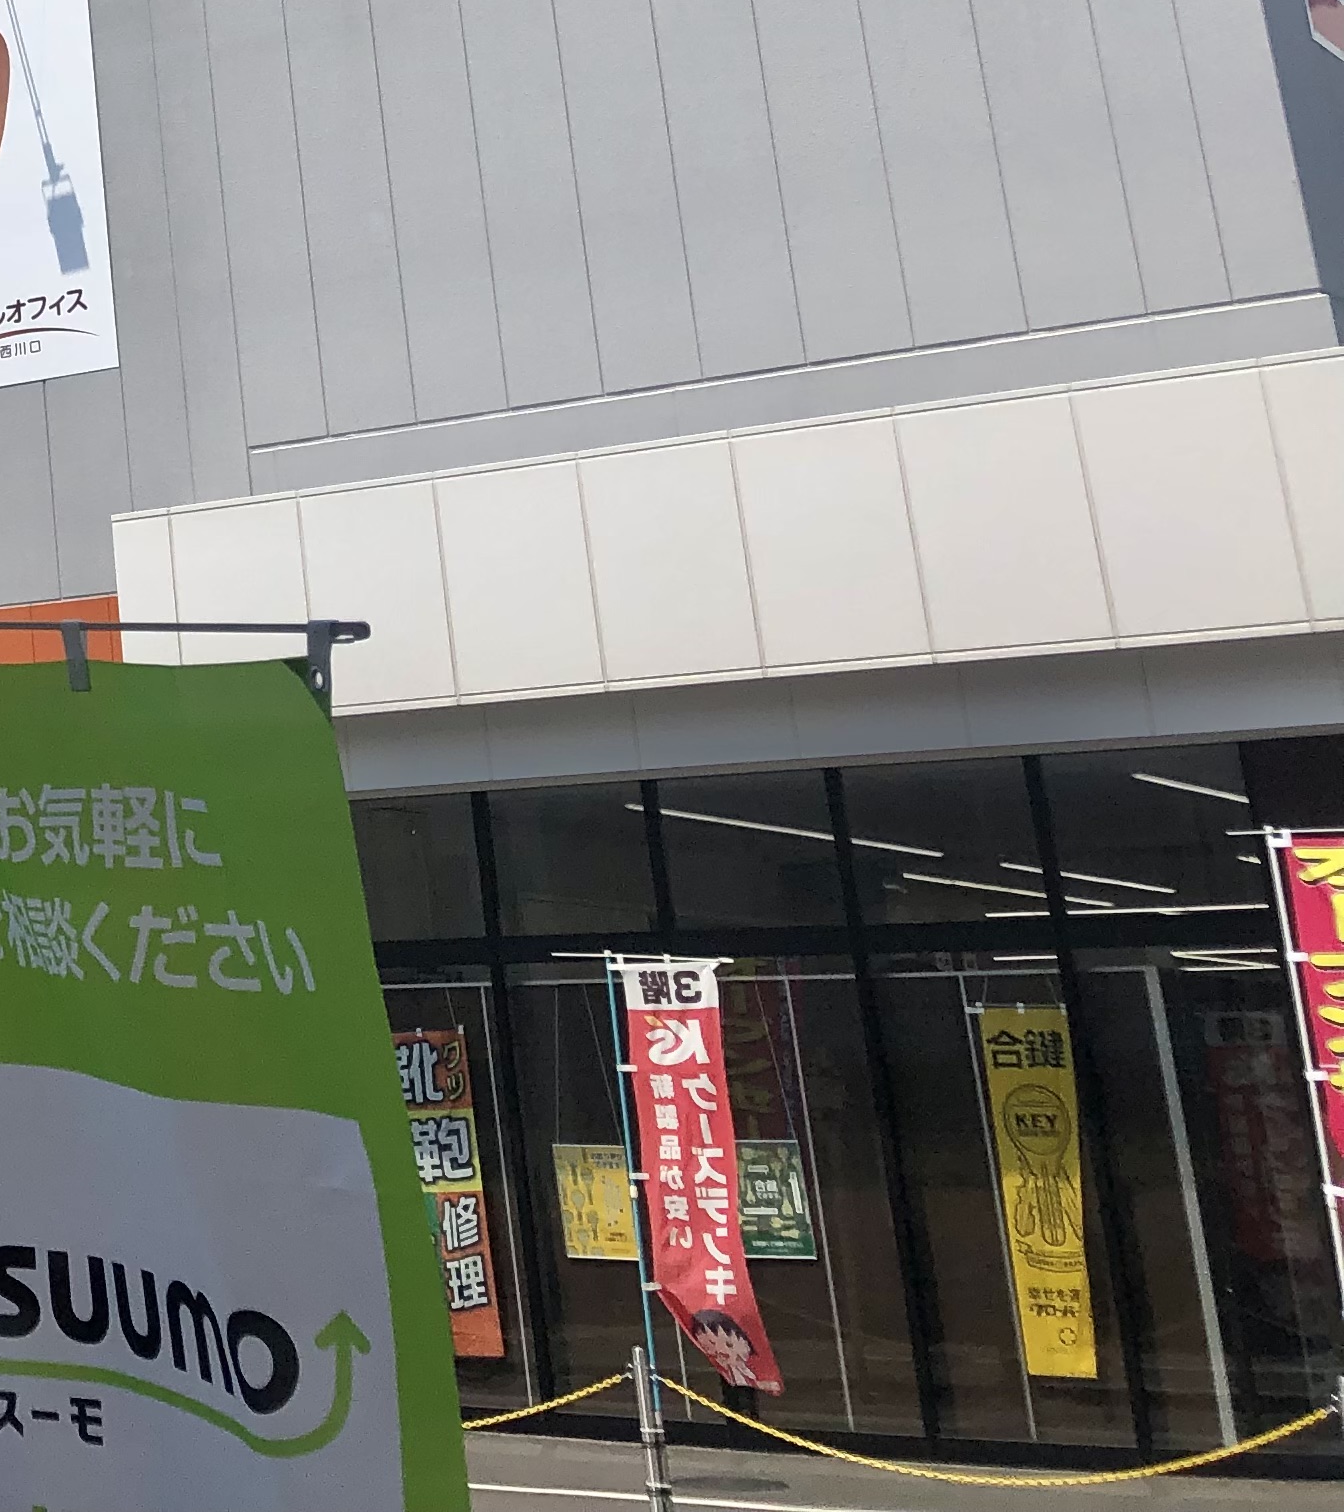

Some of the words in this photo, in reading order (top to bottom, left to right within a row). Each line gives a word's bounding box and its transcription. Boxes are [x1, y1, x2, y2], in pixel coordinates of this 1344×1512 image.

[0, 339, 42, 359] 西川口
[986, 1028, 1067, 1071] 合鍵
[442, 1040, 464, 1101] クツ
[1014, 1112, 1059, 1129] KEY
